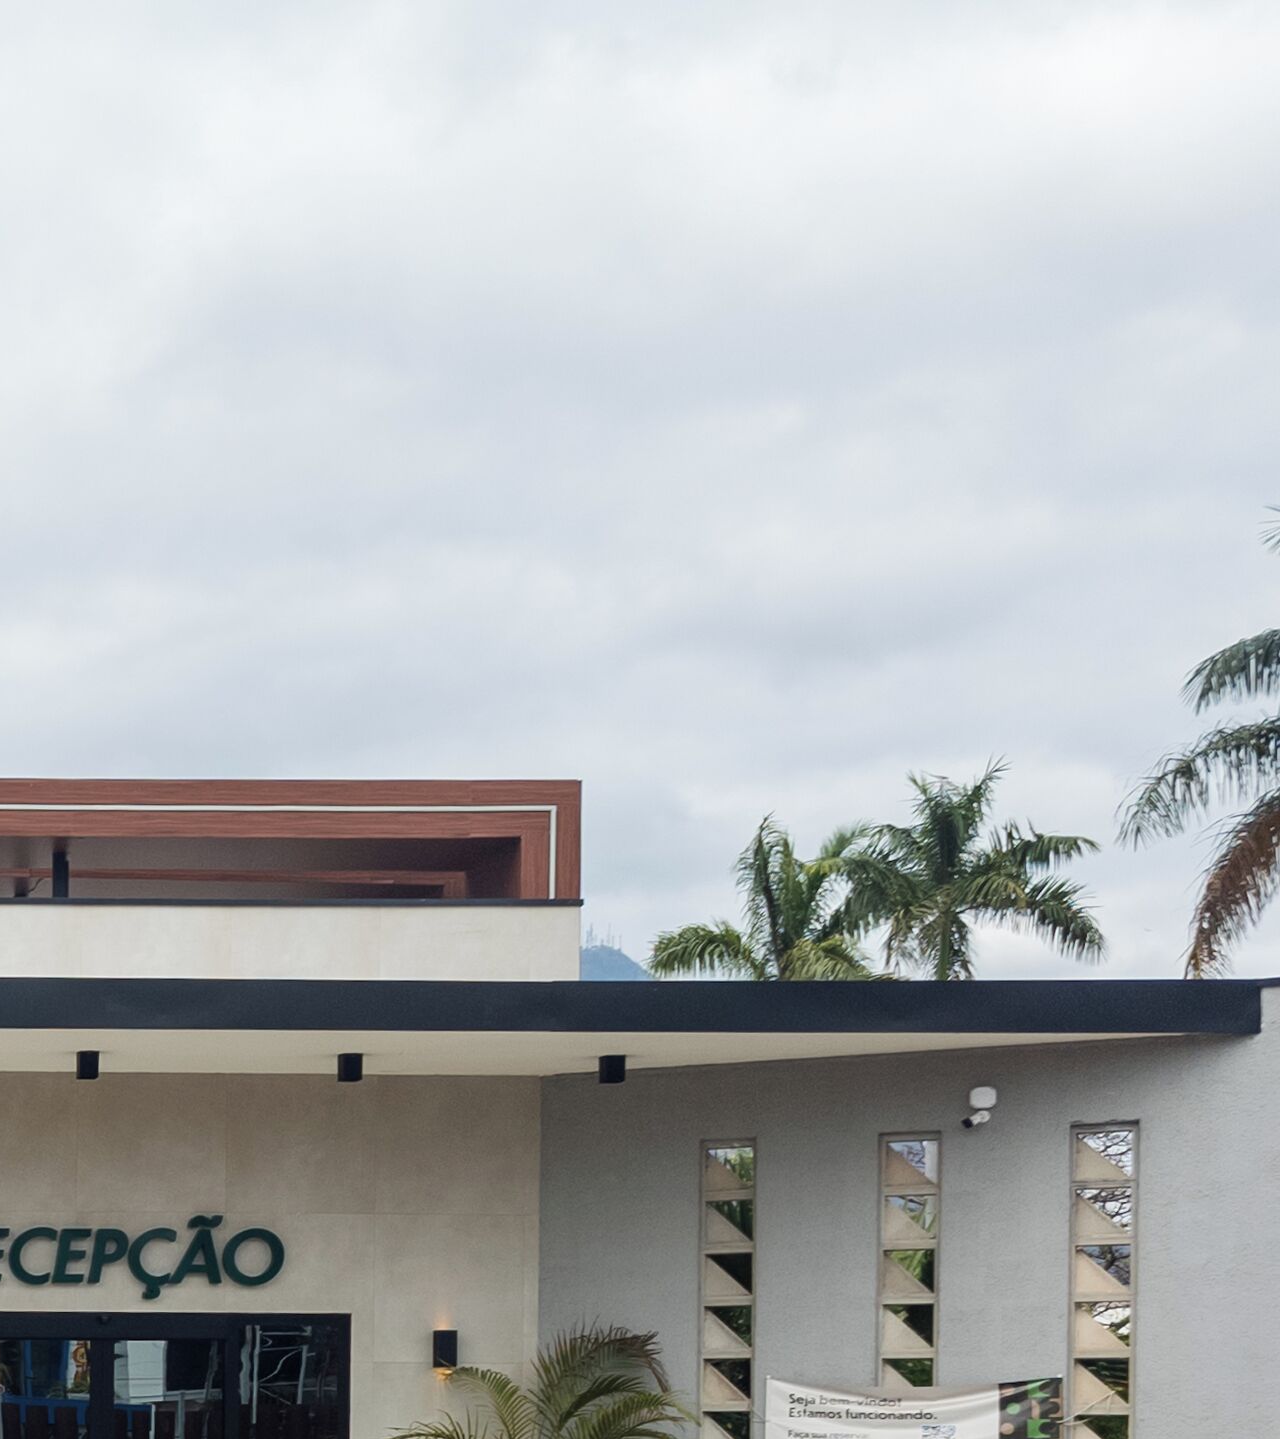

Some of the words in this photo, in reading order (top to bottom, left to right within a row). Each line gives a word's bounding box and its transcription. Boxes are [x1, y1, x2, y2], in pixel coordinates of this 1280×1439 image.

[788, 1393, 816, 1406] Seja
[788, 1407, 842, 1419] Estamos
[845, 1408, 938, 1420] funcionando.
[787, 1430, 810, 1439] Faça
